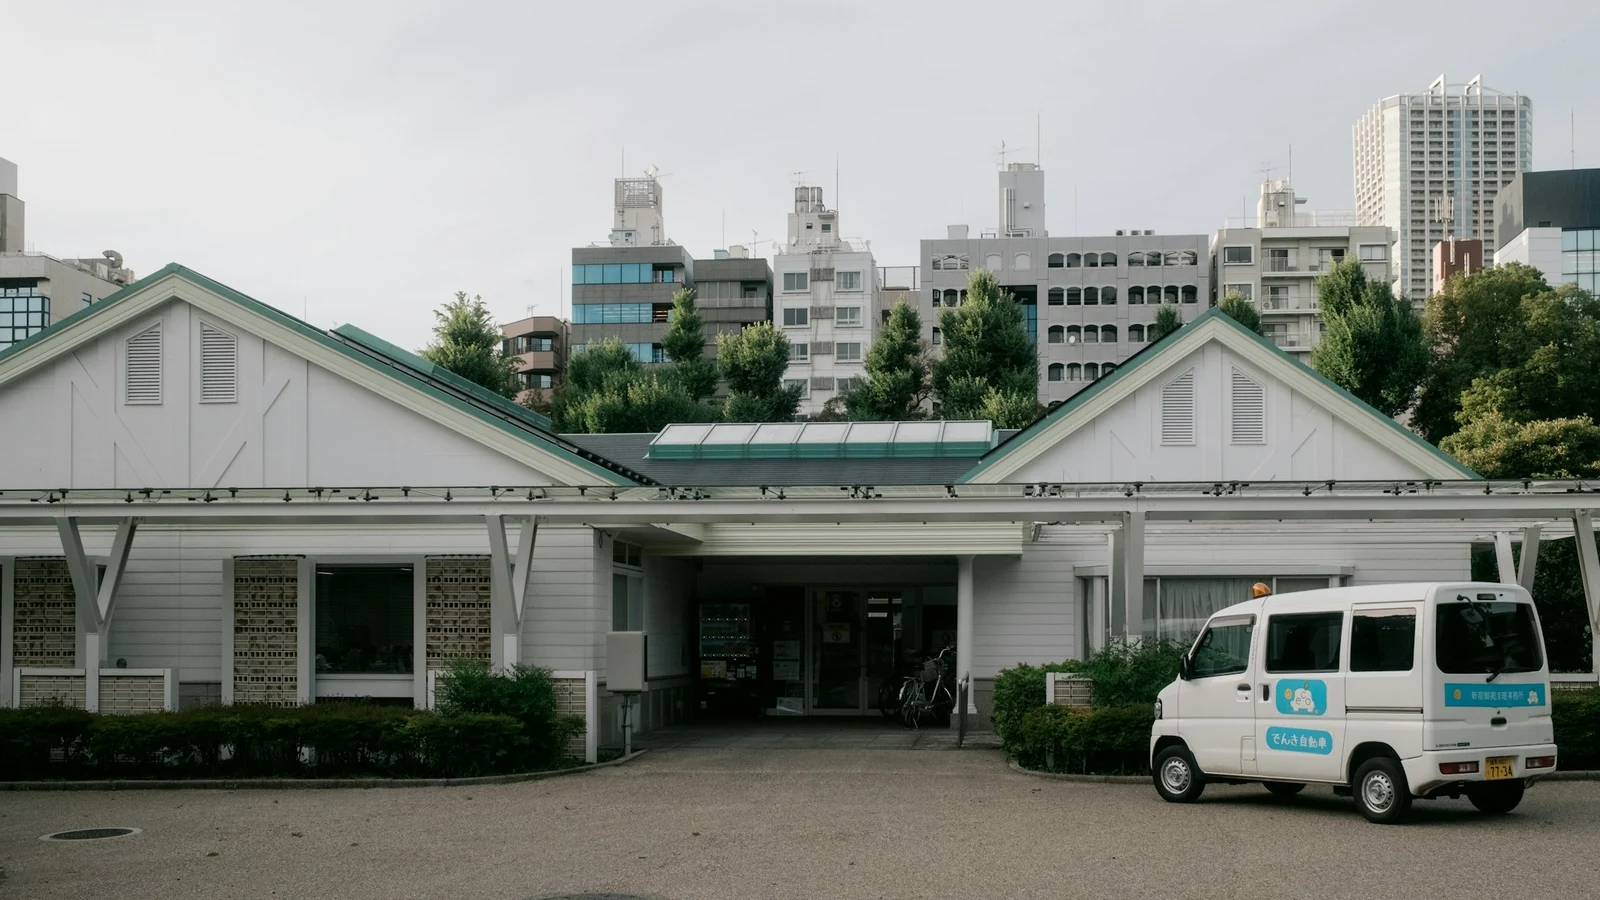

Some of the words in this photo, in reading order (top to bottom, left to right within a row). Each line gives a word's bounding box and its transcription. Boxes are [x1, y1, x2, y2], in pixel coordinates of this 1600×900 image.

[1295, 691, 1311, 705] eco
[1271, 733, 1327, 749] でんき自動車
